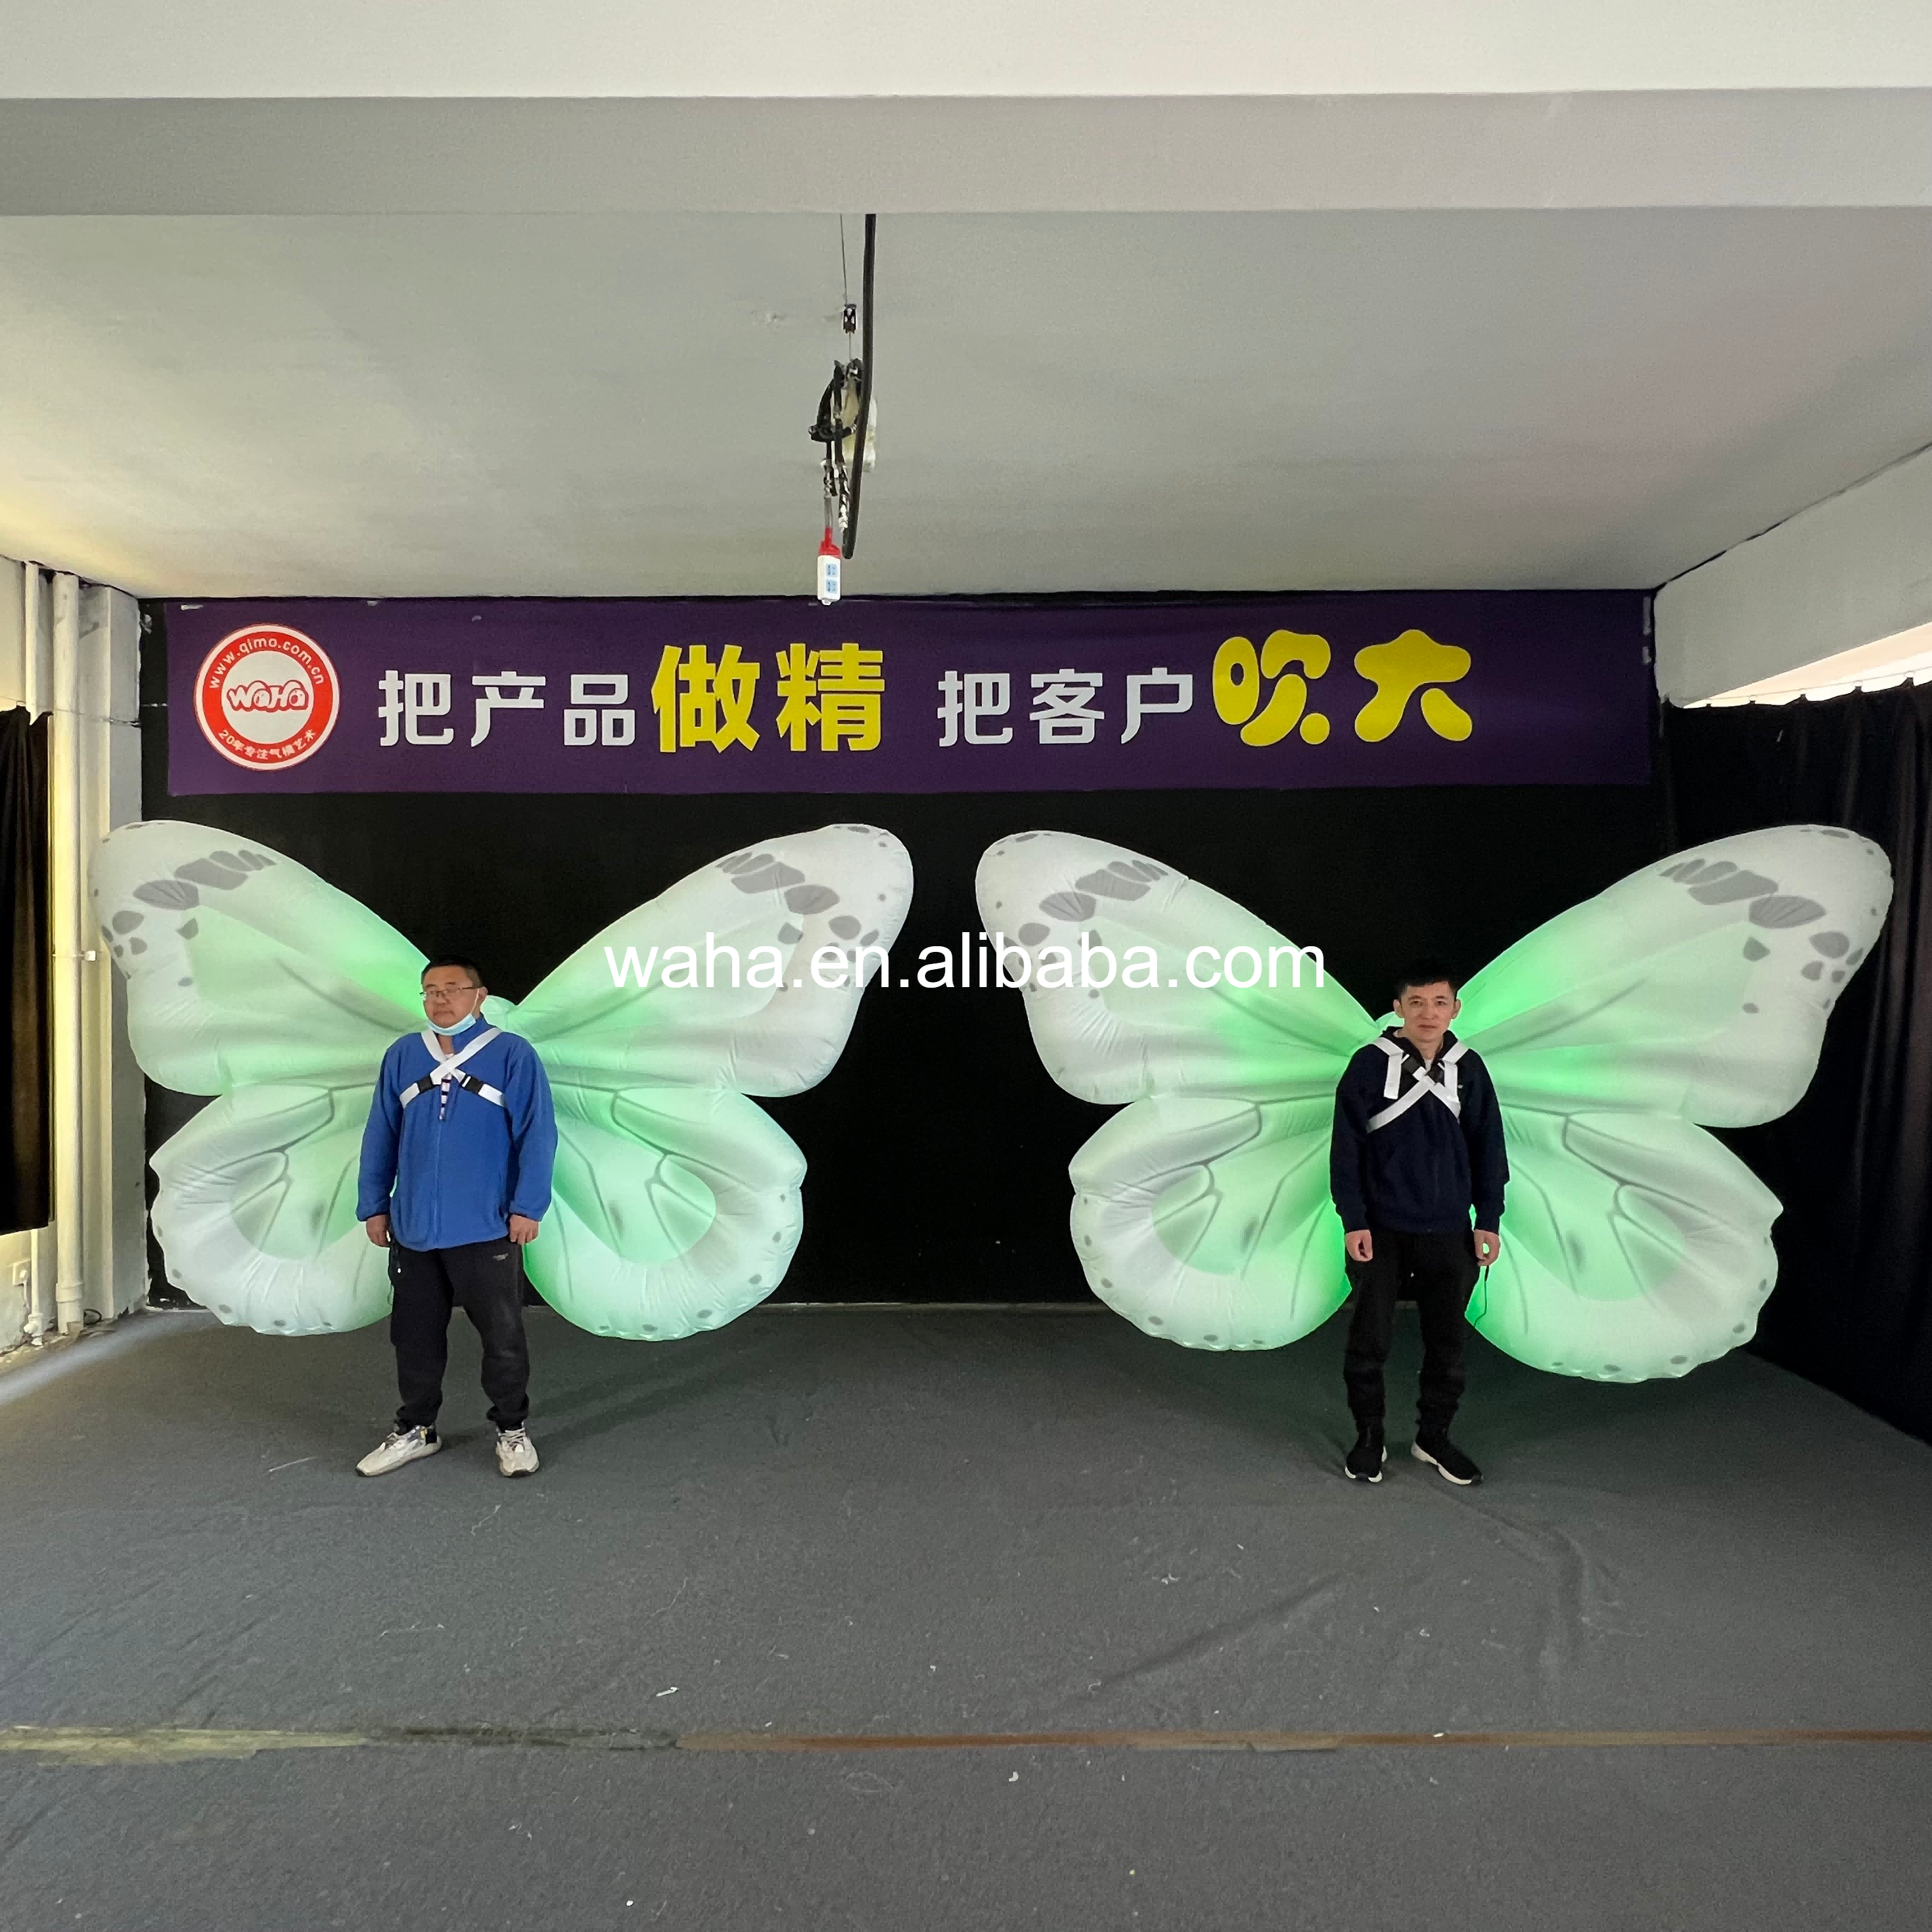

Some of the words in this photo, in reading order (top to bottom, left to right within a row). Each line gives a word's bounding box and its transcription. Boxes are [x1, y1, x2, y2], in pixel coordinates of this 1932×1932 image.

[378, 643, 884, 753] 把产品做精
[937, 630, 1472, 746] 把客户吹大
